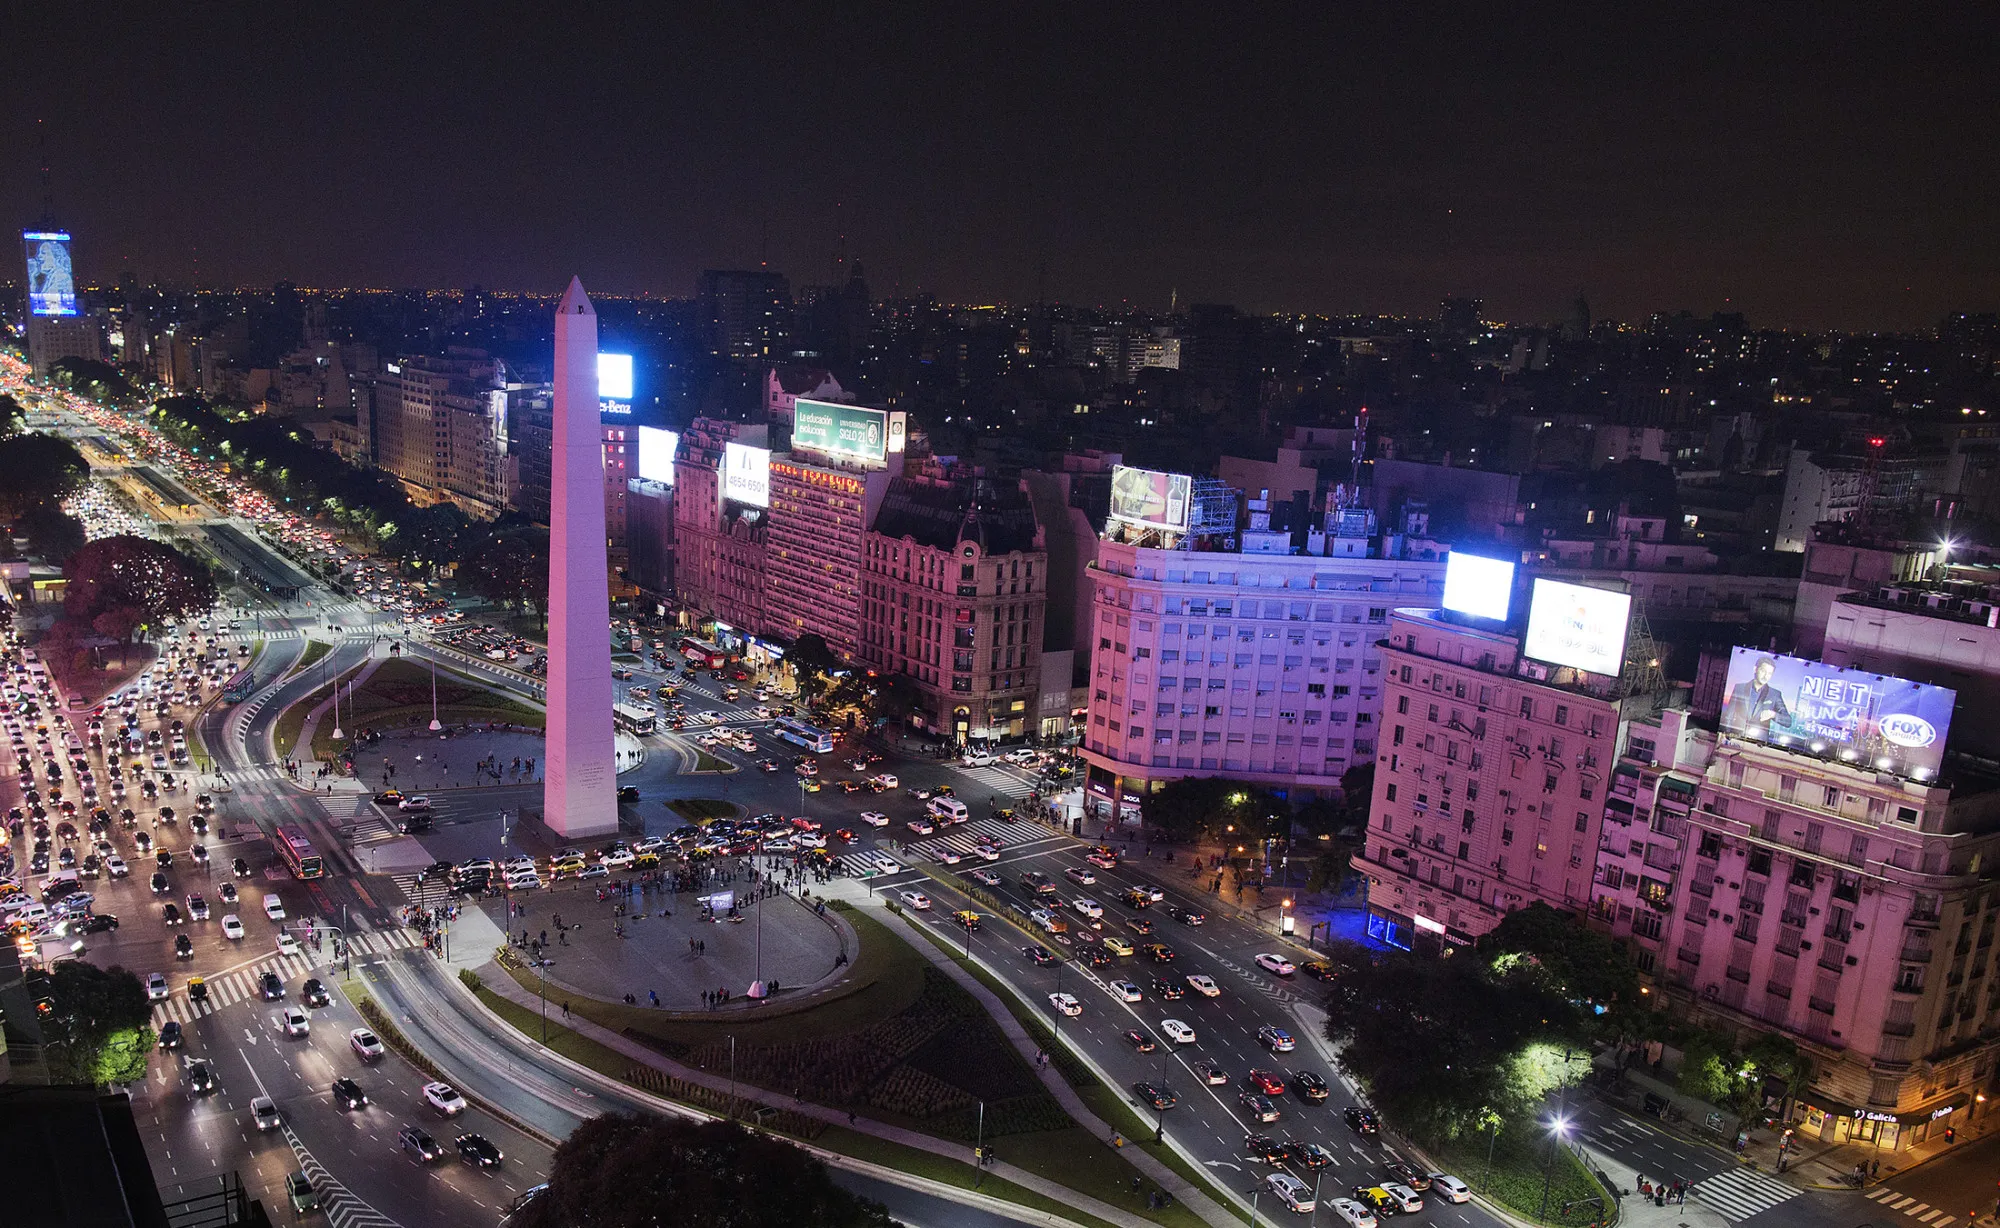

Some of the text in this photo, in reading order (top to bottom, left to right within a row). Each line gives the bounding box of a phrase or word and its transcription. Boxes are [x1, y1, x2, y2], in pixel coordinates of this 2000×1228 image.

[799, 411, 832, 426] La educación
[839, 428, 866, 443] SIGLO 21
[769, 462, 798, 475] HOTEL
[1802, 676, 1867, 704] NET
[1799, 702, 1859, 720] NUNCA
[1806, 724, 1848, 741] ES TARDE
[1891, 720, 1923, 737] FOX
[1866, 1111, 1897, 1123] Galicia
